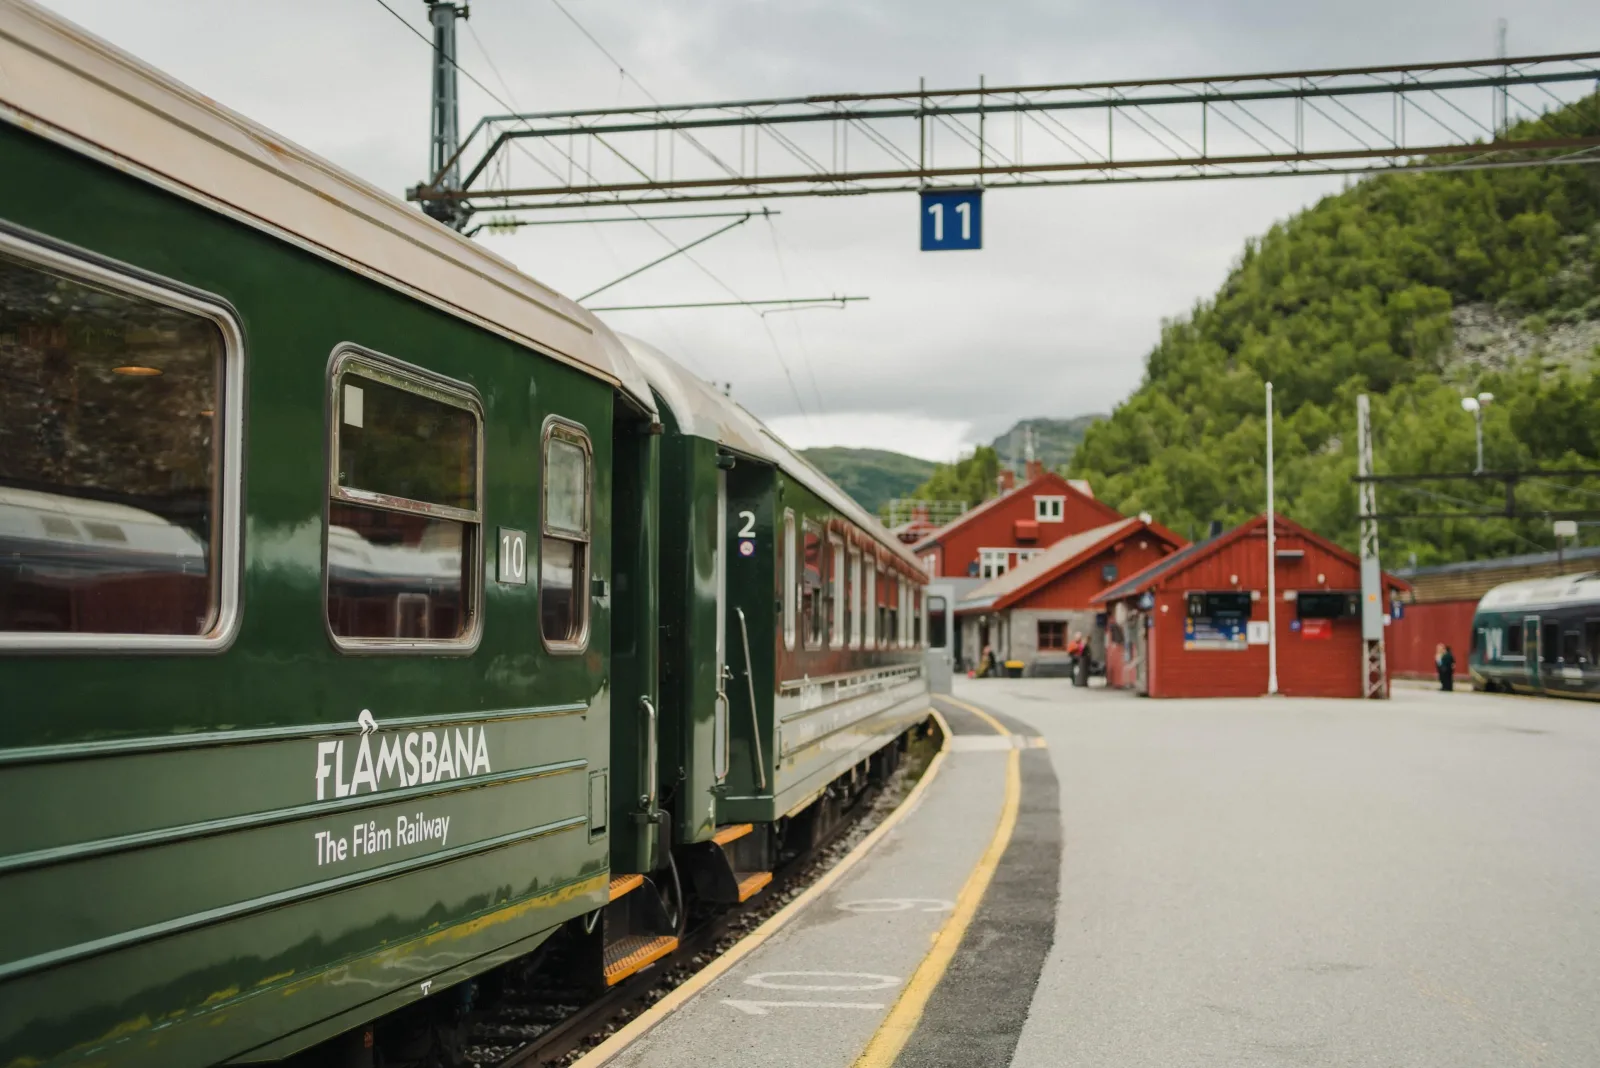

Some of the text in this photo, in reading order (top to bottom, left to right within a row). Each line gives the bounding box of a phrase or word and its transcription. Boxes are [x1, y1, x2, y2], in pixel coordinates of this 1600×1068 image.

[928, 202, 970, 241] 11
[737, 510, 756, 538] 2
[502, 535, 524, 577] 10
[315, 709, 491, 800] FLÅMSBANA
[315, 812, 450, 866] The Flåm Railway
